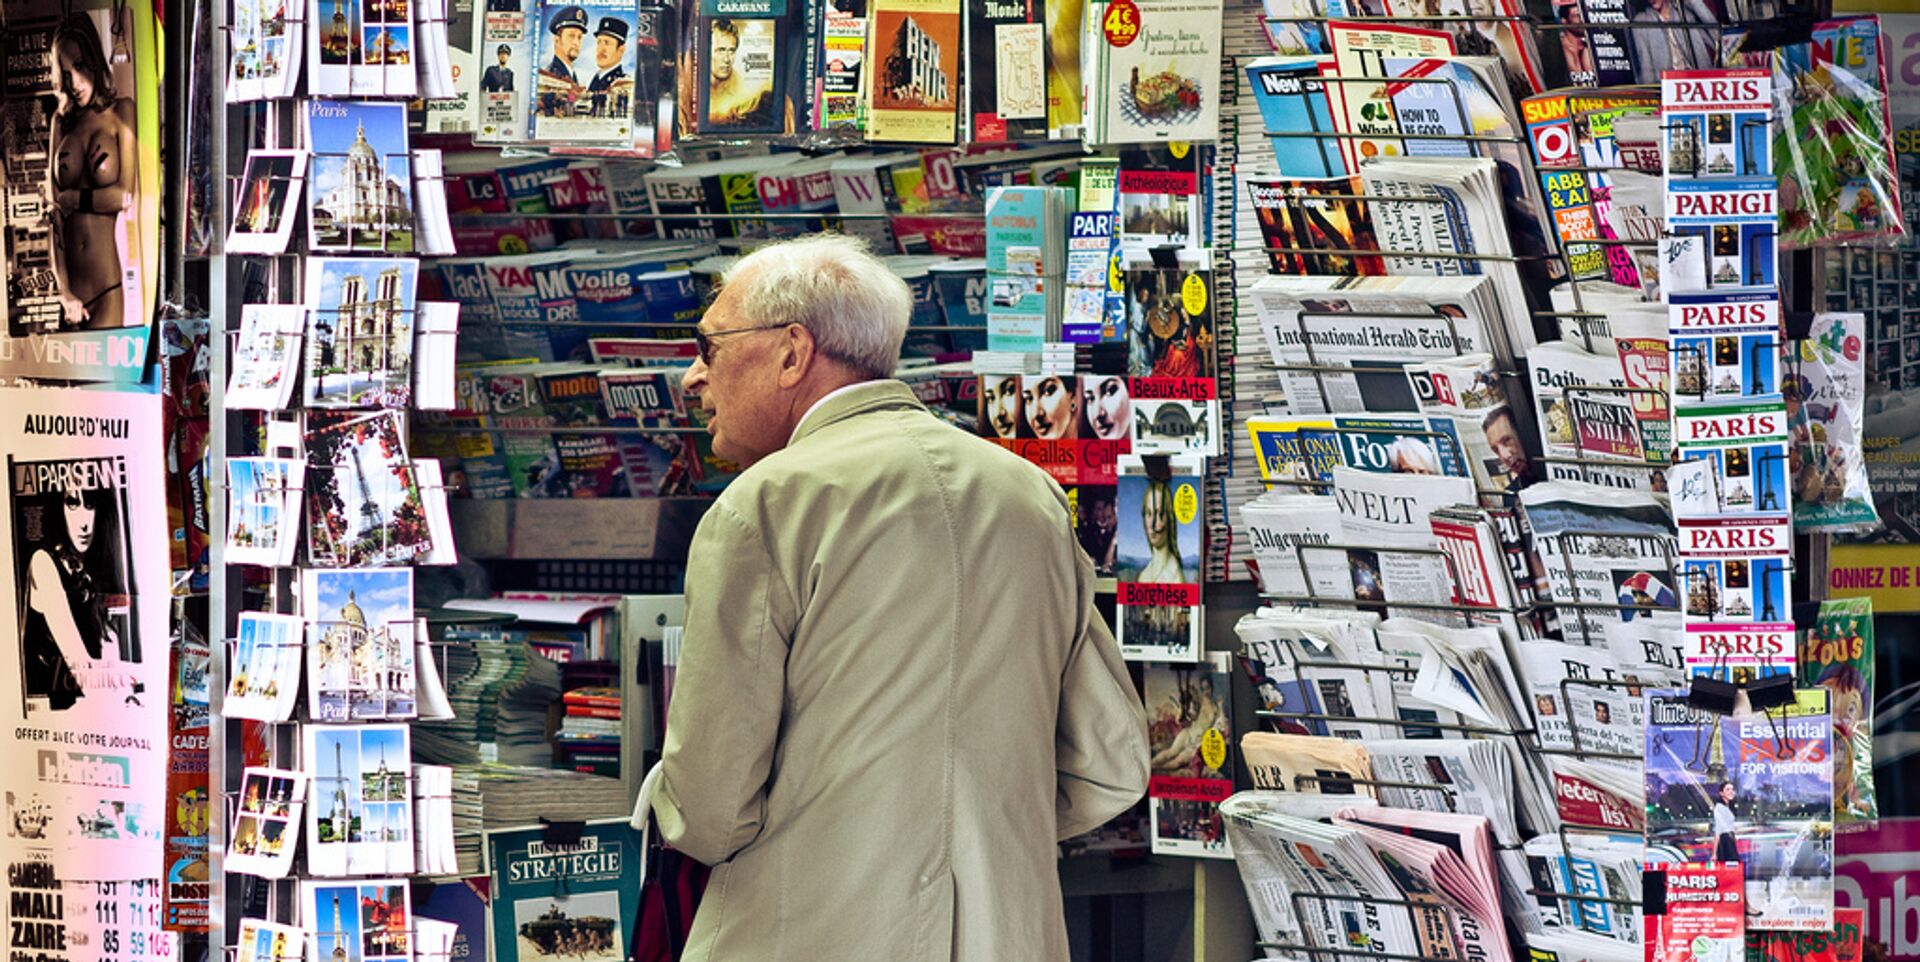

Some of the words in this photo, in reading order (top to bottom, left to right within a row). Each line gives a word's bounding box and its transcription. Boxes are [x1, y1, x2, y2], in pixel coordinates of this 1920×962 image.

[984, 3, 1026, 19] Monde
[1674, 80, 1759, 102] PARIS
[310, 103, 348, 118] Paris
[1400, 108, 1424, 123] HOW
[1425, 108, 1440, 123] TO
[1122, 173, 1190, 194] Archéologique
[1674, 193, 1773, 216] PARIGI
[571, 270, 632, 291] Voile
[1681, 303, 1767, 327] PARIS
[1370, 325, 1419, 349] Herald
[106, 335, 144, 367] ICI
[549, 376, 599, 398] moto
[1133, 378, 1209, 399] Beaux-Arts
[1536, 367, 1587, 399] Daily
[610, 382, 660, 417] MOTO
[23, 414, 129, 439] AUJOURD'HUI
[1339, 487, 1418, 526] WELT
[1249, 526, 1331, 555] Allgemeine
[1690, 527, 1776, 550] PARIS
[1889, 566, 1911, 588] DE
[1125, 583, 1189, 608] Borghèse
[1699, 633, 1784, 655] PARIS
[14, 727, 50, 742] OFFERT
[1739, 721, 1826, 739] Essential
[1739, 762, 1767, 775] FOR
[1768, 762, 1827, 776] VISITORS
[510, 852, 620, 881] STRATEGIE
[1667, 874, 1719, 890] PARIS
[10, 891, 64, 920] MALI
[95, 900, 118, 925] 111
[1760, 918, 1795, 929] explore
[1801, 918, 1827, 930] enjoy
[10, 921, 67, 951] ZAIRE
[102, 928, 120, 954] 85
